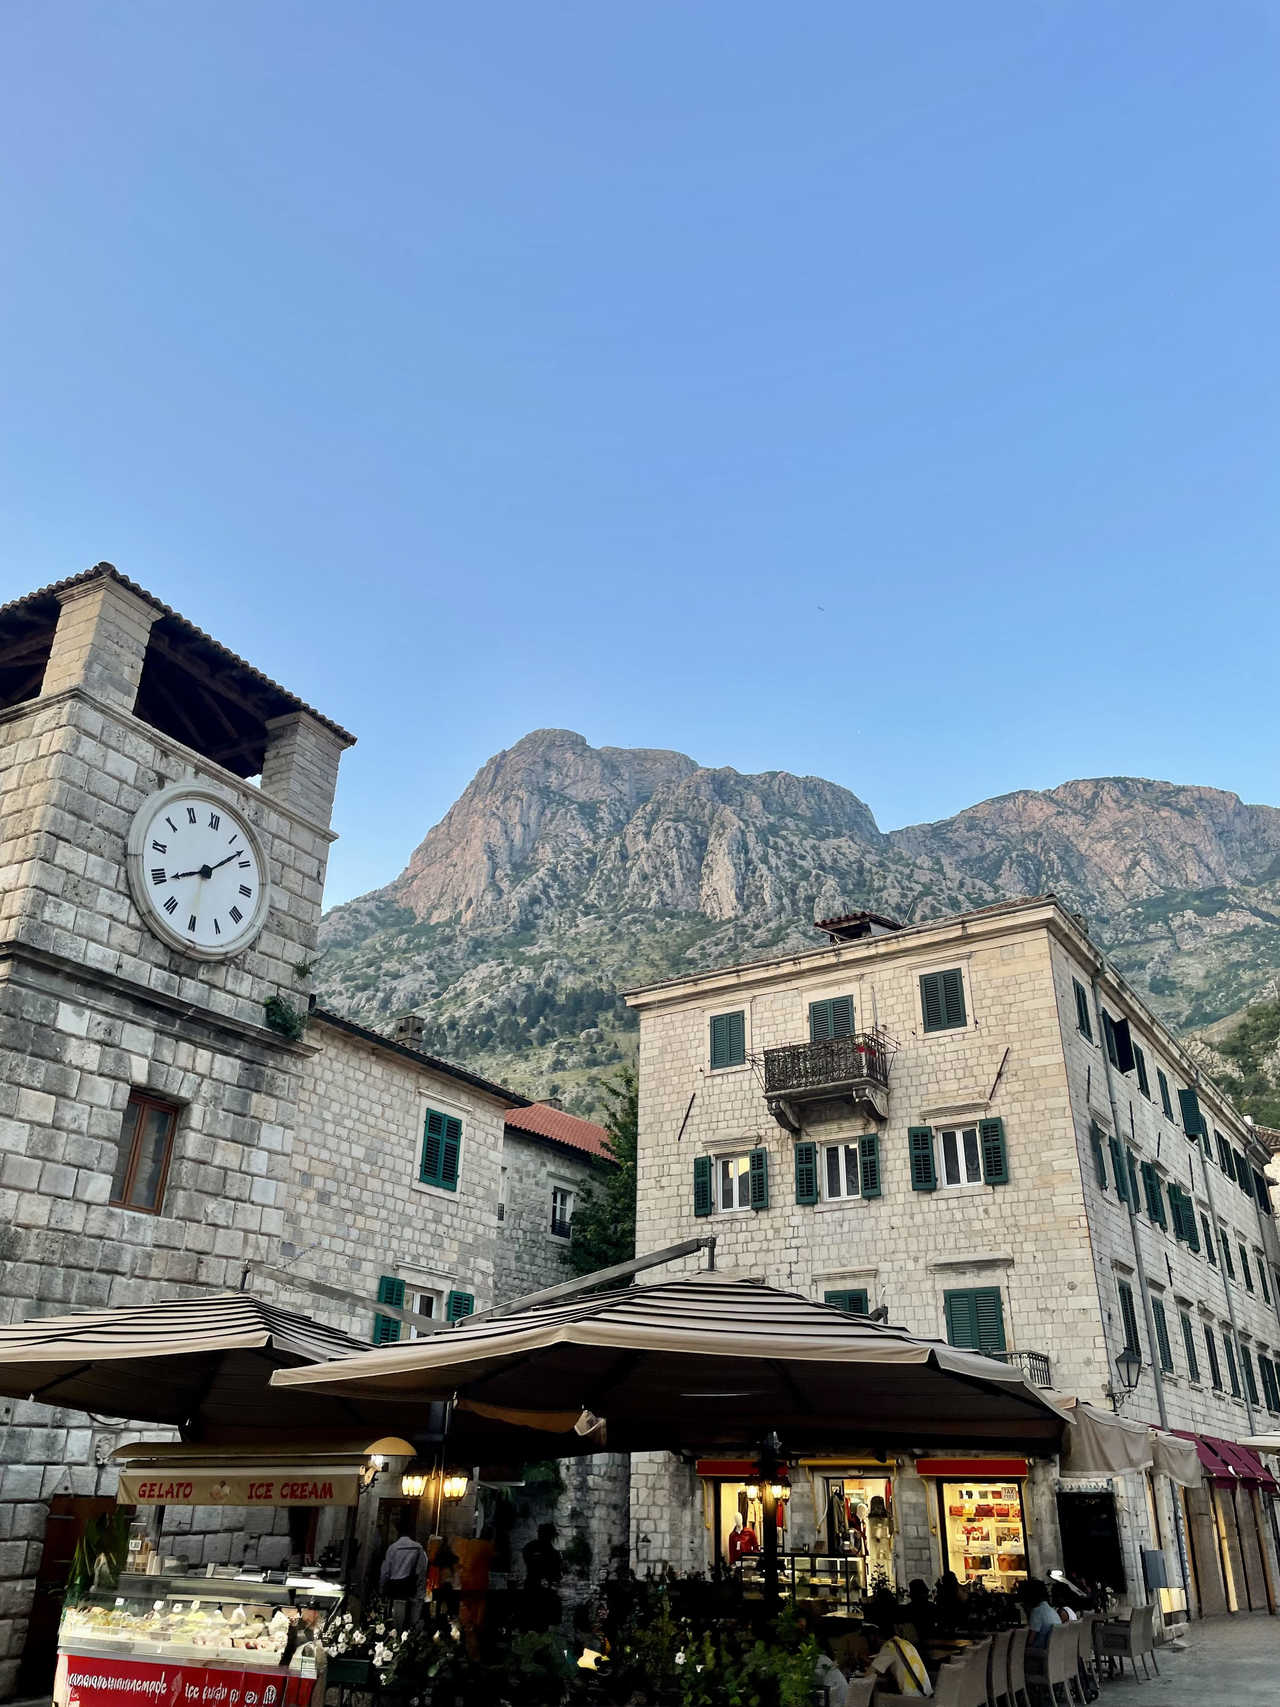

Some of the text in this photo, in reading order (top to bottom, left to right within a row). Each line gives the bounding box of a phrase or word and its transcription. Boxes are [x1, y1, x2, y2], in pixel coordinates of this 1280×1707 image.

[187, 807, 197, 824] XI
[207, 812, 220, 831] XII
[165, 816, 178, 833] X
[152, 839, 167, 854] IX
[228, 834, 237, 845] I
[238, 860, 251, 868] II
[151, 868, 167, 885] VIII
[238, 884, 252, 898] III
[163, 896, 178, 915] VII
[188, 914, 196, 932] VI
[214, 918, 221, 935] V
[138, 1482, 334, 1500] GELATO ICE CREAM
